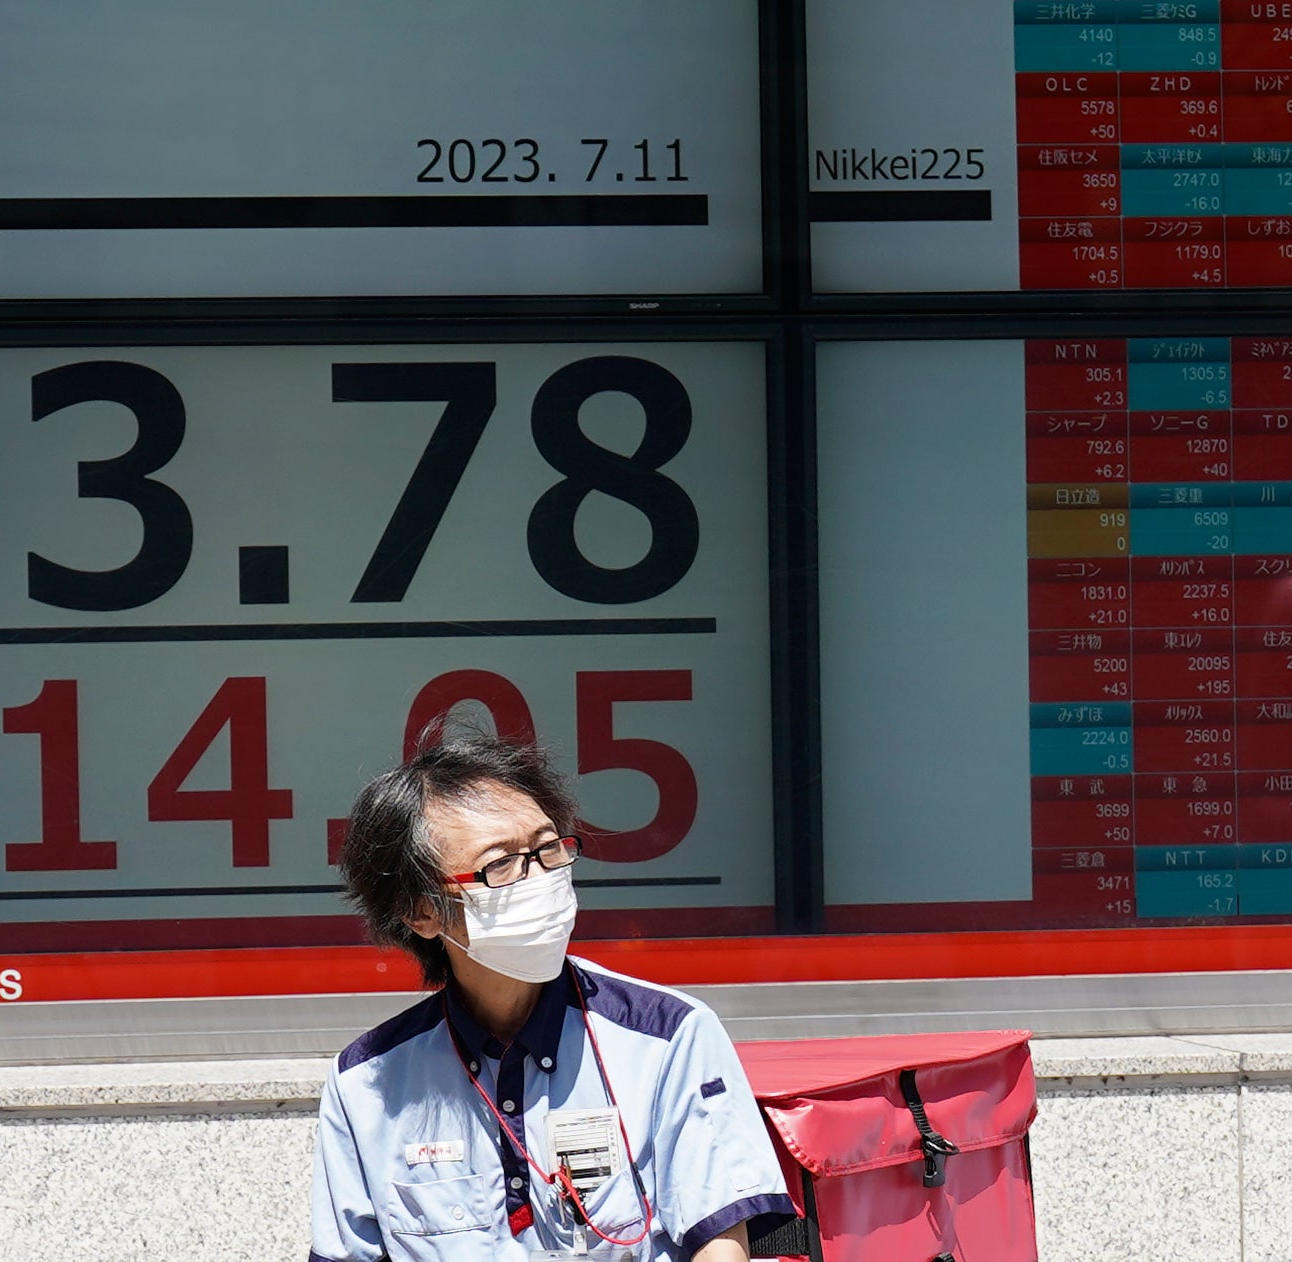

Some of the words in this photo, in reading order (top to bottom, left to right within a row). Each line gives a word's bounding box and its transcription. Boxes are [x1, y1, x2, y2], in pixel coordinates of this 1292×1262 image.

[1078, 27, 1114, 43] 4140
[1178, 27, 1217, 43] 848.5
[1091, 51, 1114, 67] -12
[1080, 100, 1116, 116] 5578
[1179, 99, 1219, 115] 369.6
[1089, 123, 1116, 140] +50
[815, 148, 986, 184] Nikkei225
[1082, 172, 1117, 188] 3650
[1173, 172, 1220, 188] 2747.0
[1072, 245, 1119, 261] 1704.5
[1175, 244, 1222, 260] 1179.0
[1085, 367, 1122, 383] 305.1
[1094, 390, 1125, 406] +2.3
[1086, 439, 1125, 455] 792.6
[1186, 438, 1228, 454] 12870
[1099, 512, 1127, 528] 919
[1193, 511, 1229, 527] 6509
[1081, 585, 1127, 601] 1831.0
[1093, 657, 1128, 673] 5200
